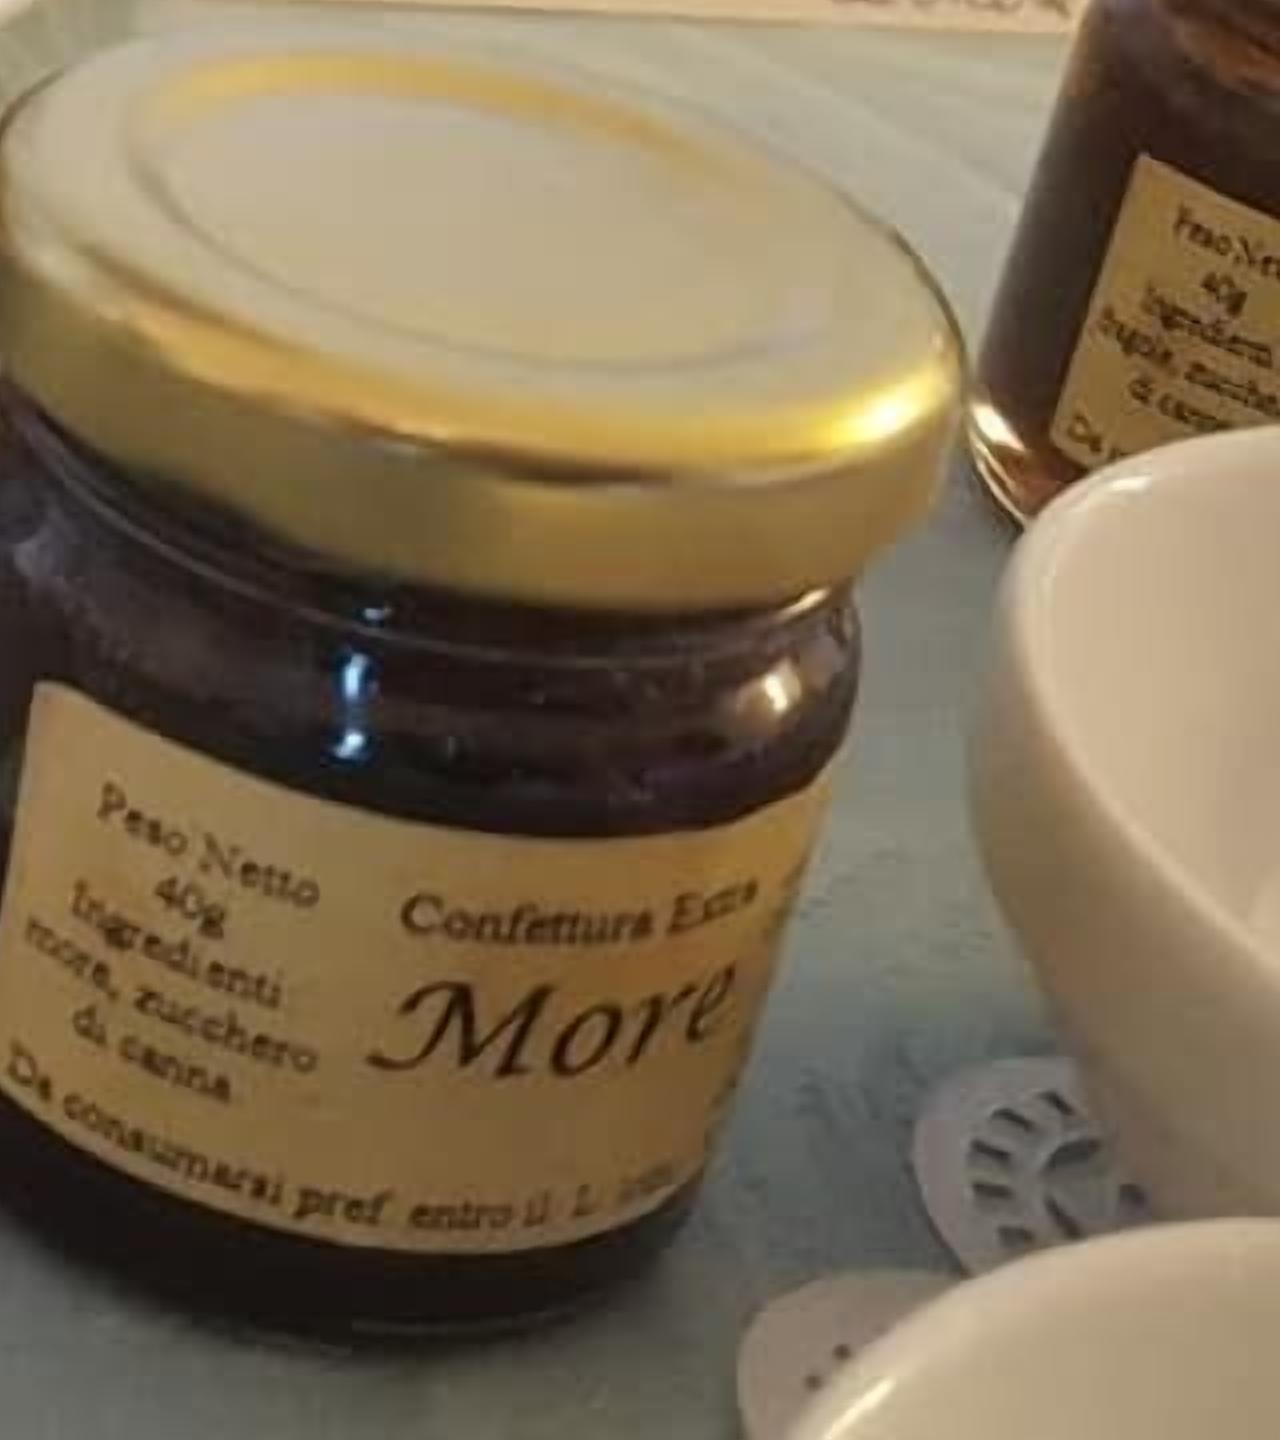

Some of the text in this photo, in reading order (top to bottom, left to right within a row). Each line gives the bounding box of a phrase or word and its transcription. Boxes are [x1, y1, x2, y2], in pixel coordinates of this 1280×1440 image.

[96, 781, 321, 908] Peso Netto
[71, 876, 284, 1009] Ingredienti
[154, 875, 226, 941] 40g
[399, 890, 654, 947] Confettura
[72, 1004, 232, 1105] di canna
[134, 984, 320, 1074] zucchero
[363, 963, 737, 1079] More
[7, 1040, 53, 1101] Da
[62, 1091, 285, 1206] consumarsi
[407, 1197, 514, 1231] entro
